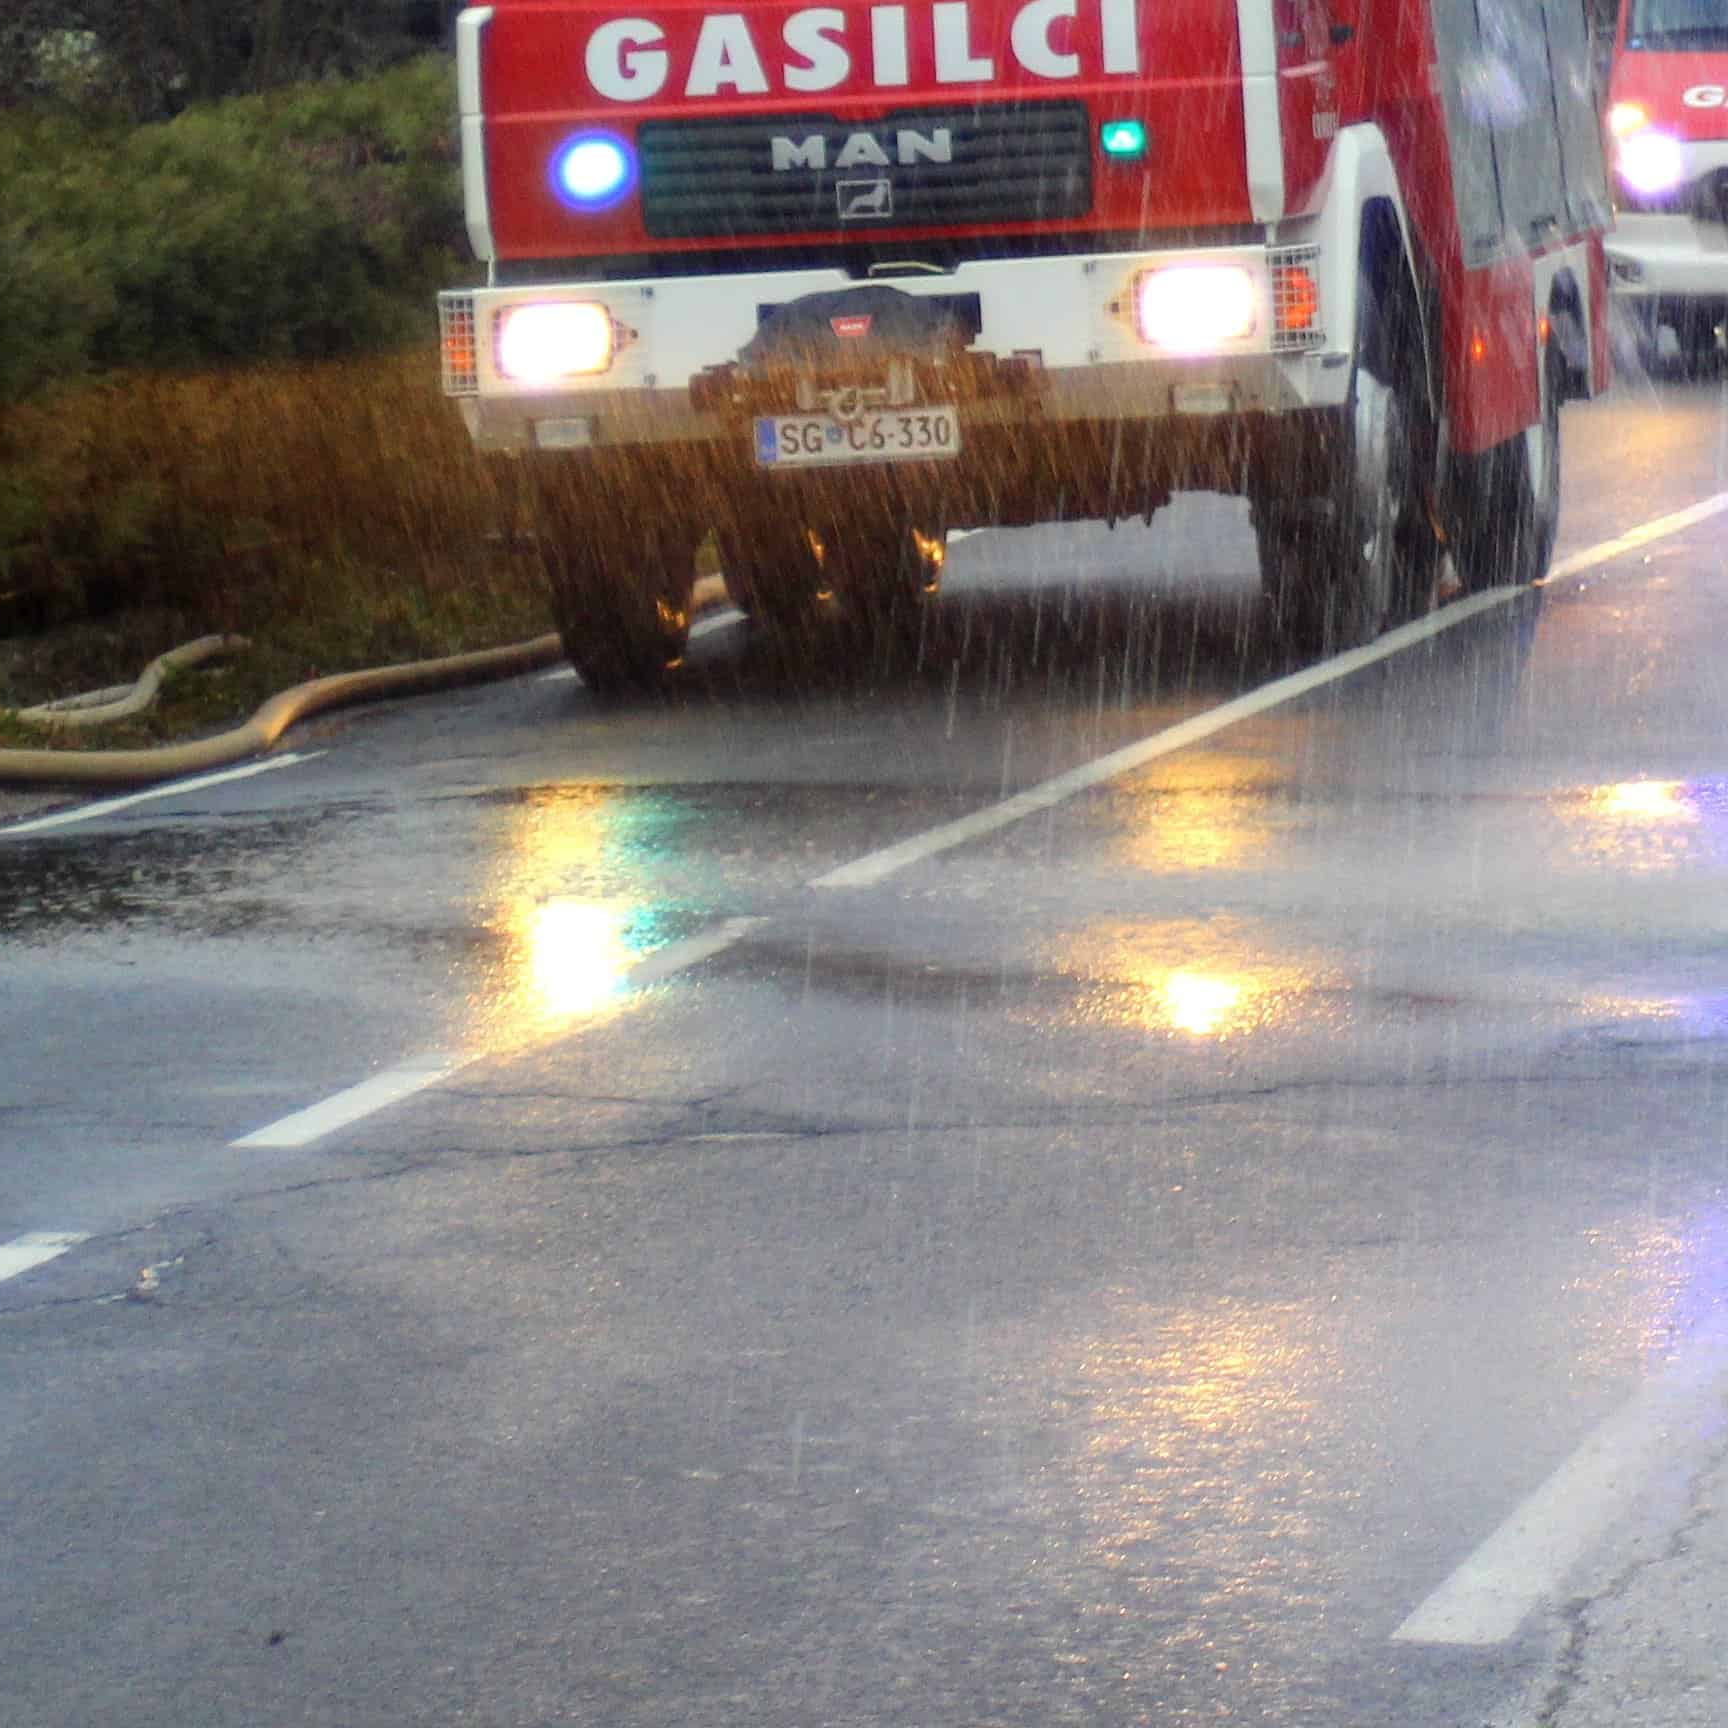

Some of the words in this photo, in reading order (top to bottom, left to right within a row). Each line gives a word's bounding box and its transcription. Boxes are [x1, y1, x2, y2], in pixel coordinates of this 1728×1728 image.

[771, 127, 953, 171] MAN
[779, 422, 822, 455] SG
[846, 414, 951, 451] C6-330
